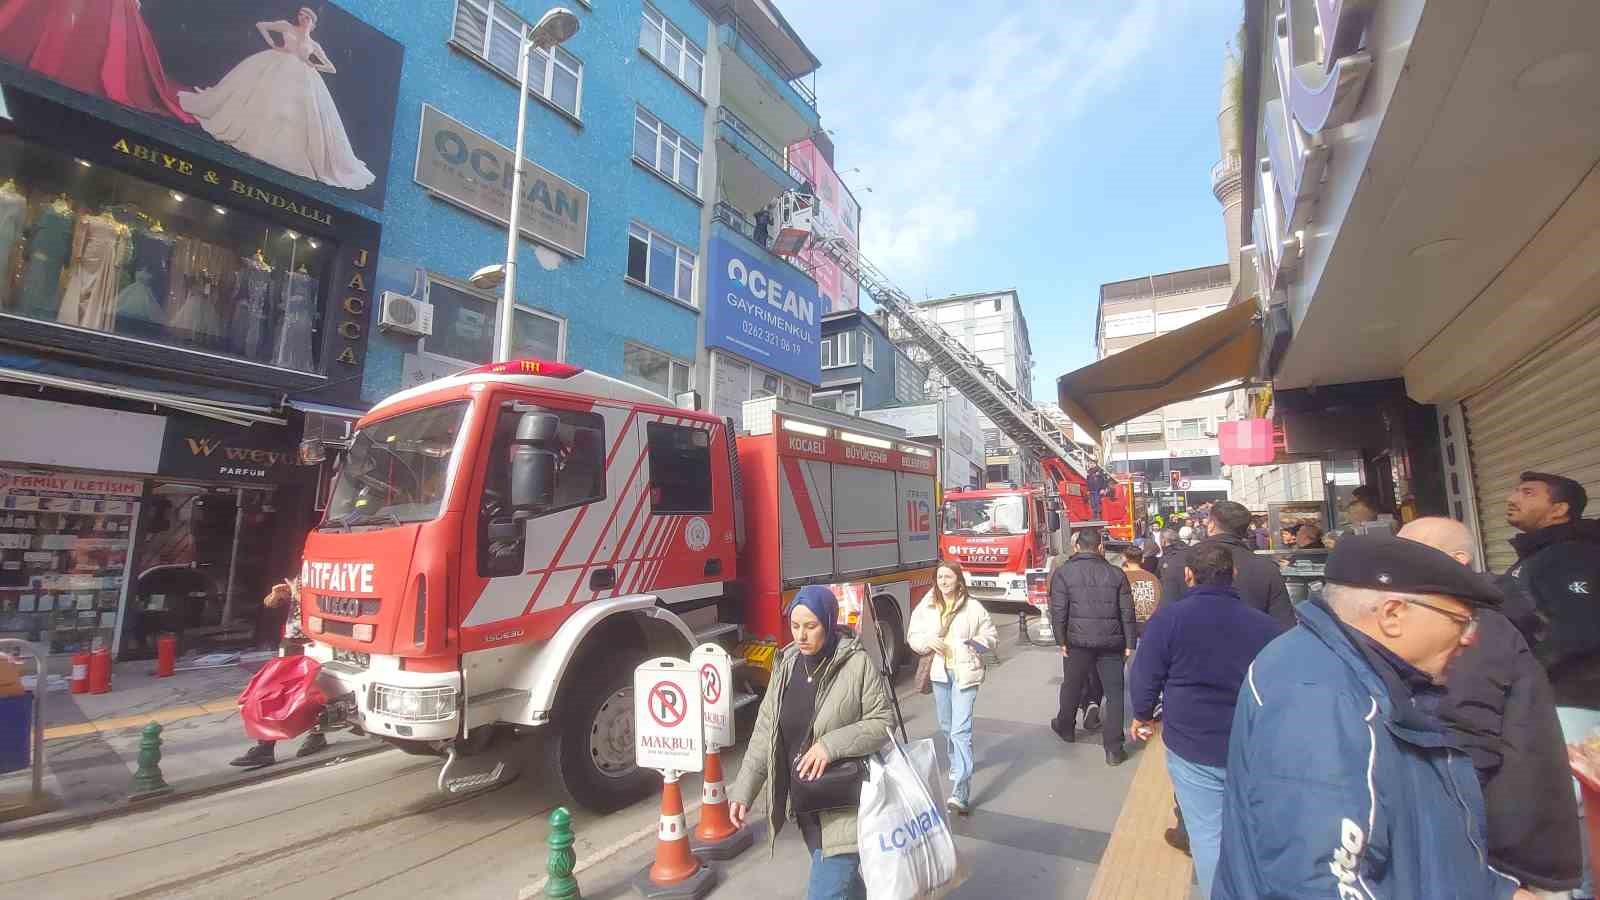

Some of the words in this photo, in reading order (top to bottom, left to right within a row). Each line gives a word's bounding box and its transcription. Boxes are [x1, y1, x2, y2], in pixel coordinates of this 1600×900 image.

[204, 168, 219, 185] &
[434, 129, 580, 225] OCEAN
[335, 249, 369, 366] JACCA
[727, 258, 814, 326] OCEAN
[742, 320, 764, 341] 0262
[641, 735, 697, 752] MAKBUL
